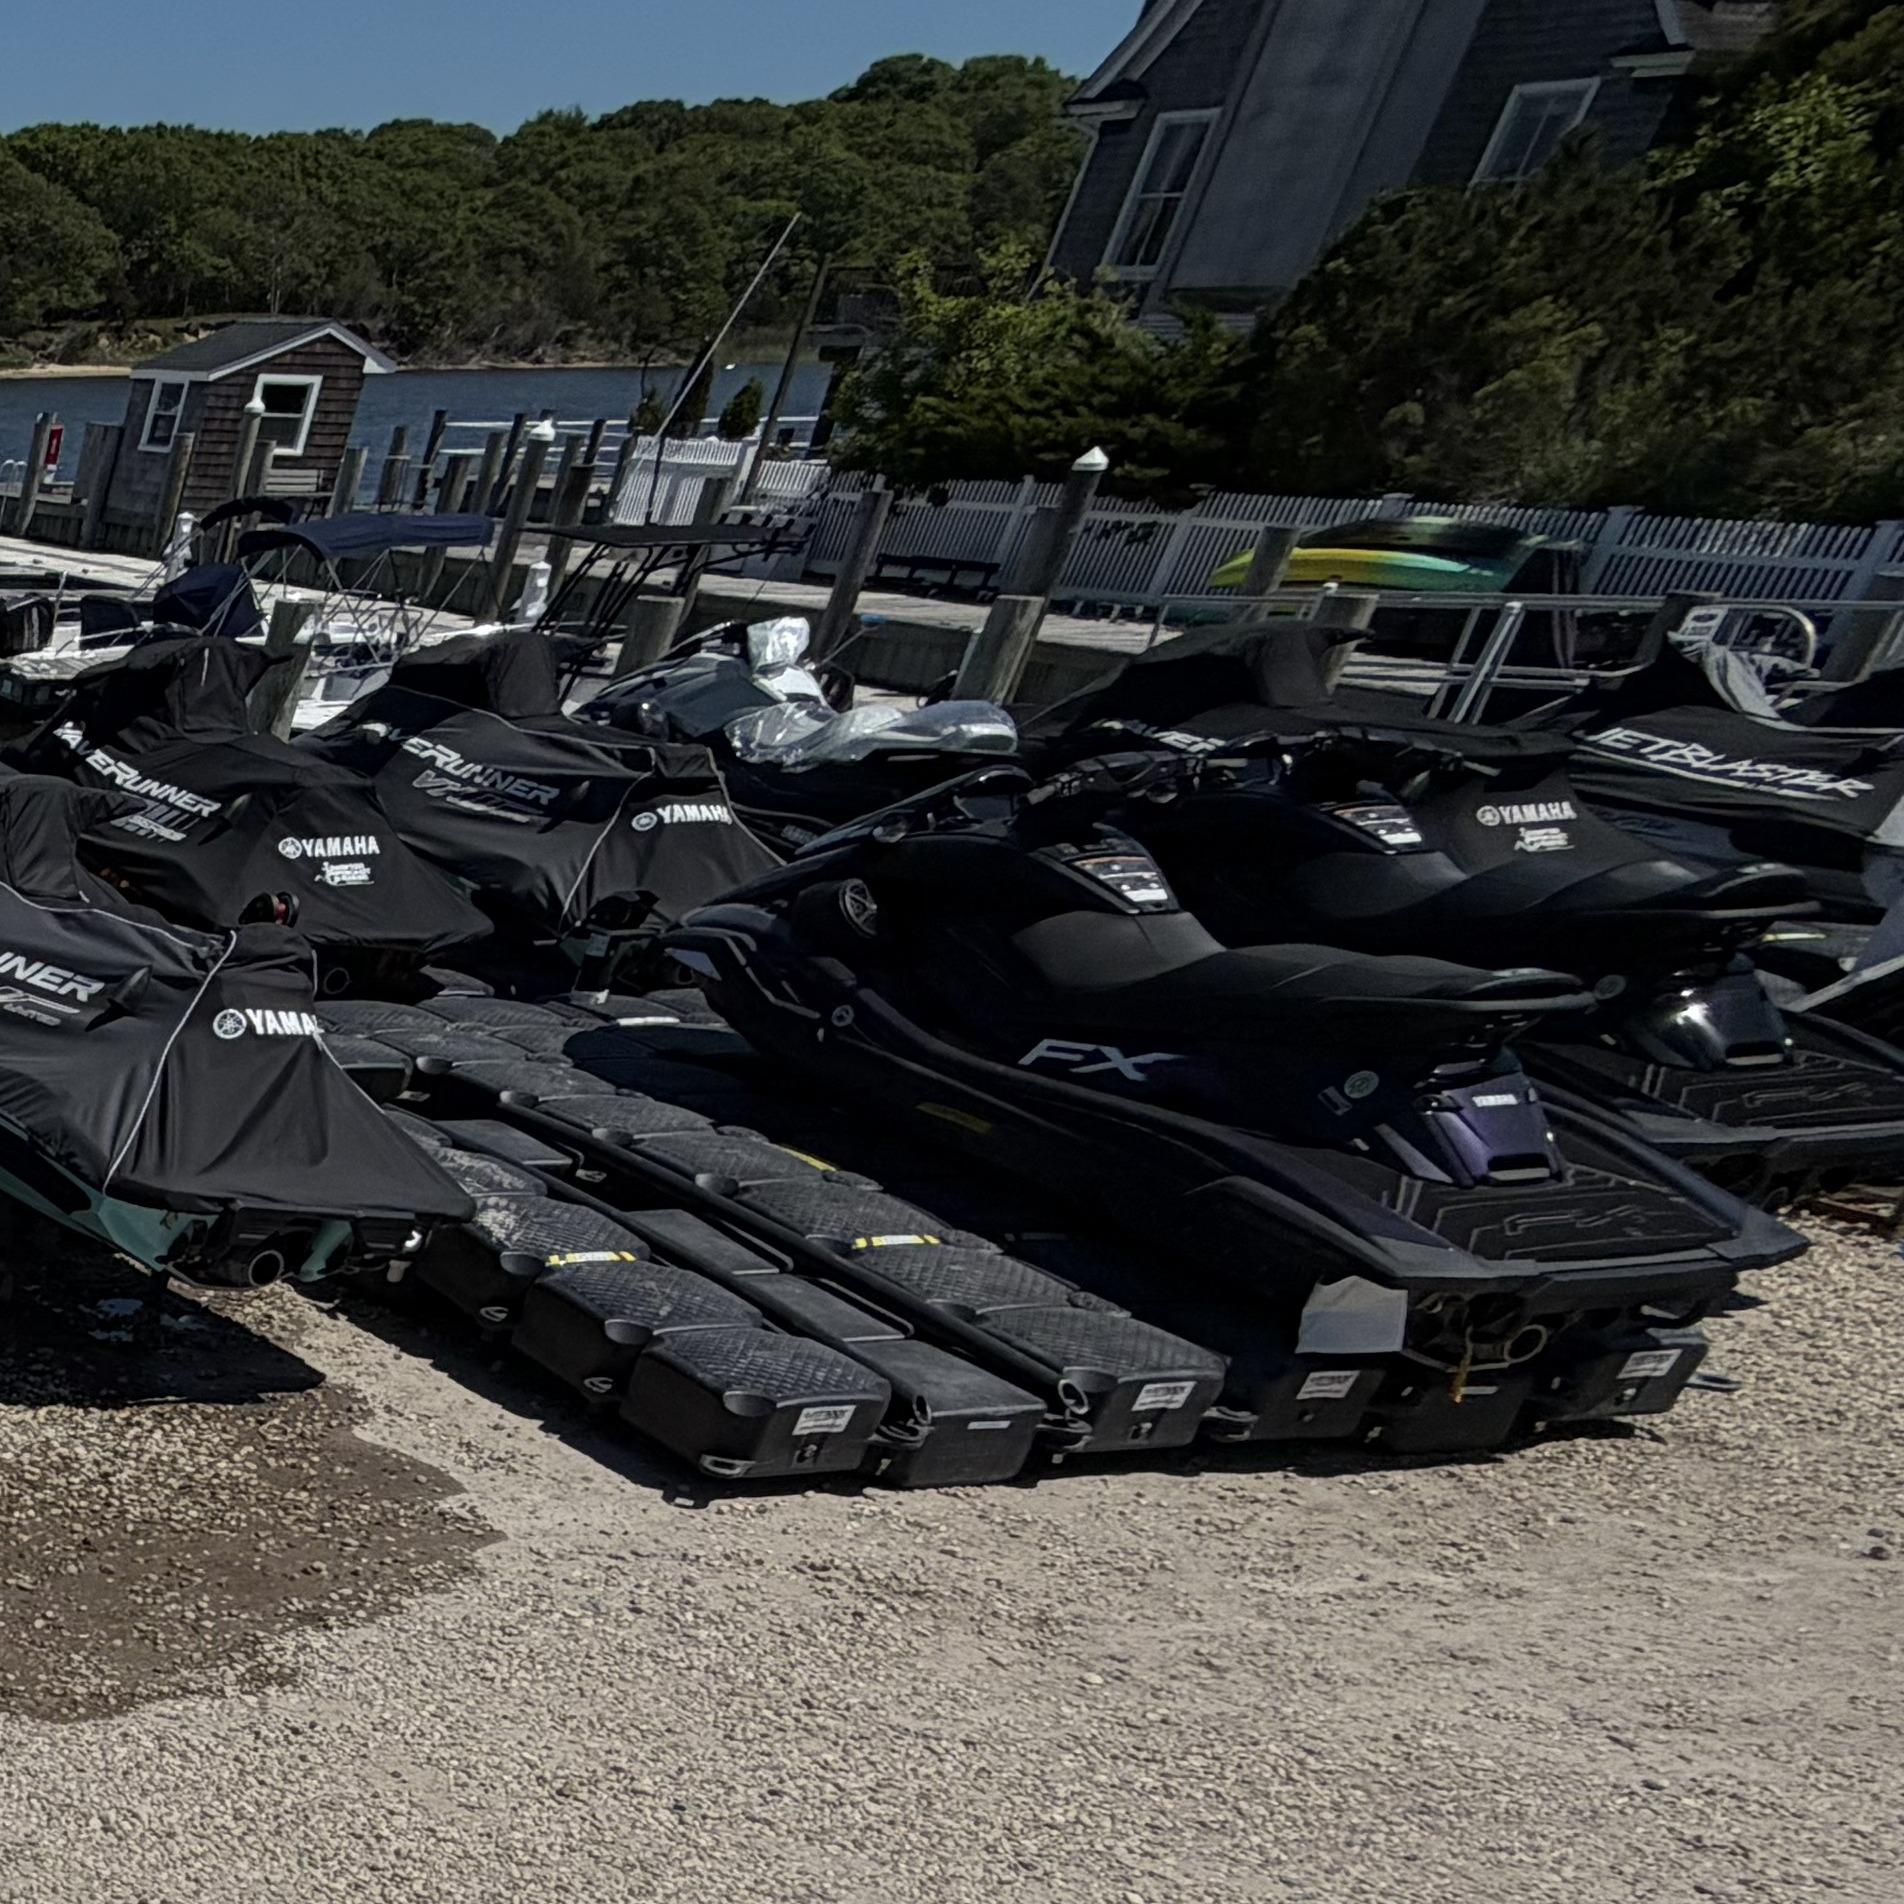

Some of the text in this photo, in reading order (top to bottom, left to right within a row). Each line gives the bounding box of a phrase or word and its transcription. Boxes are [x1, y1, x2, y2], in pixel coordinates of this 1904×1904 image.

[1585, 727, 1876, 798] JETBLASTER
[1498, 801, 1578, 824] YAMAHA
[301, 835, 381, 858] YAMAHA
[244, 1008, 319, 1037] YAMA
[1017, 1038, 1184, 1082] FX
